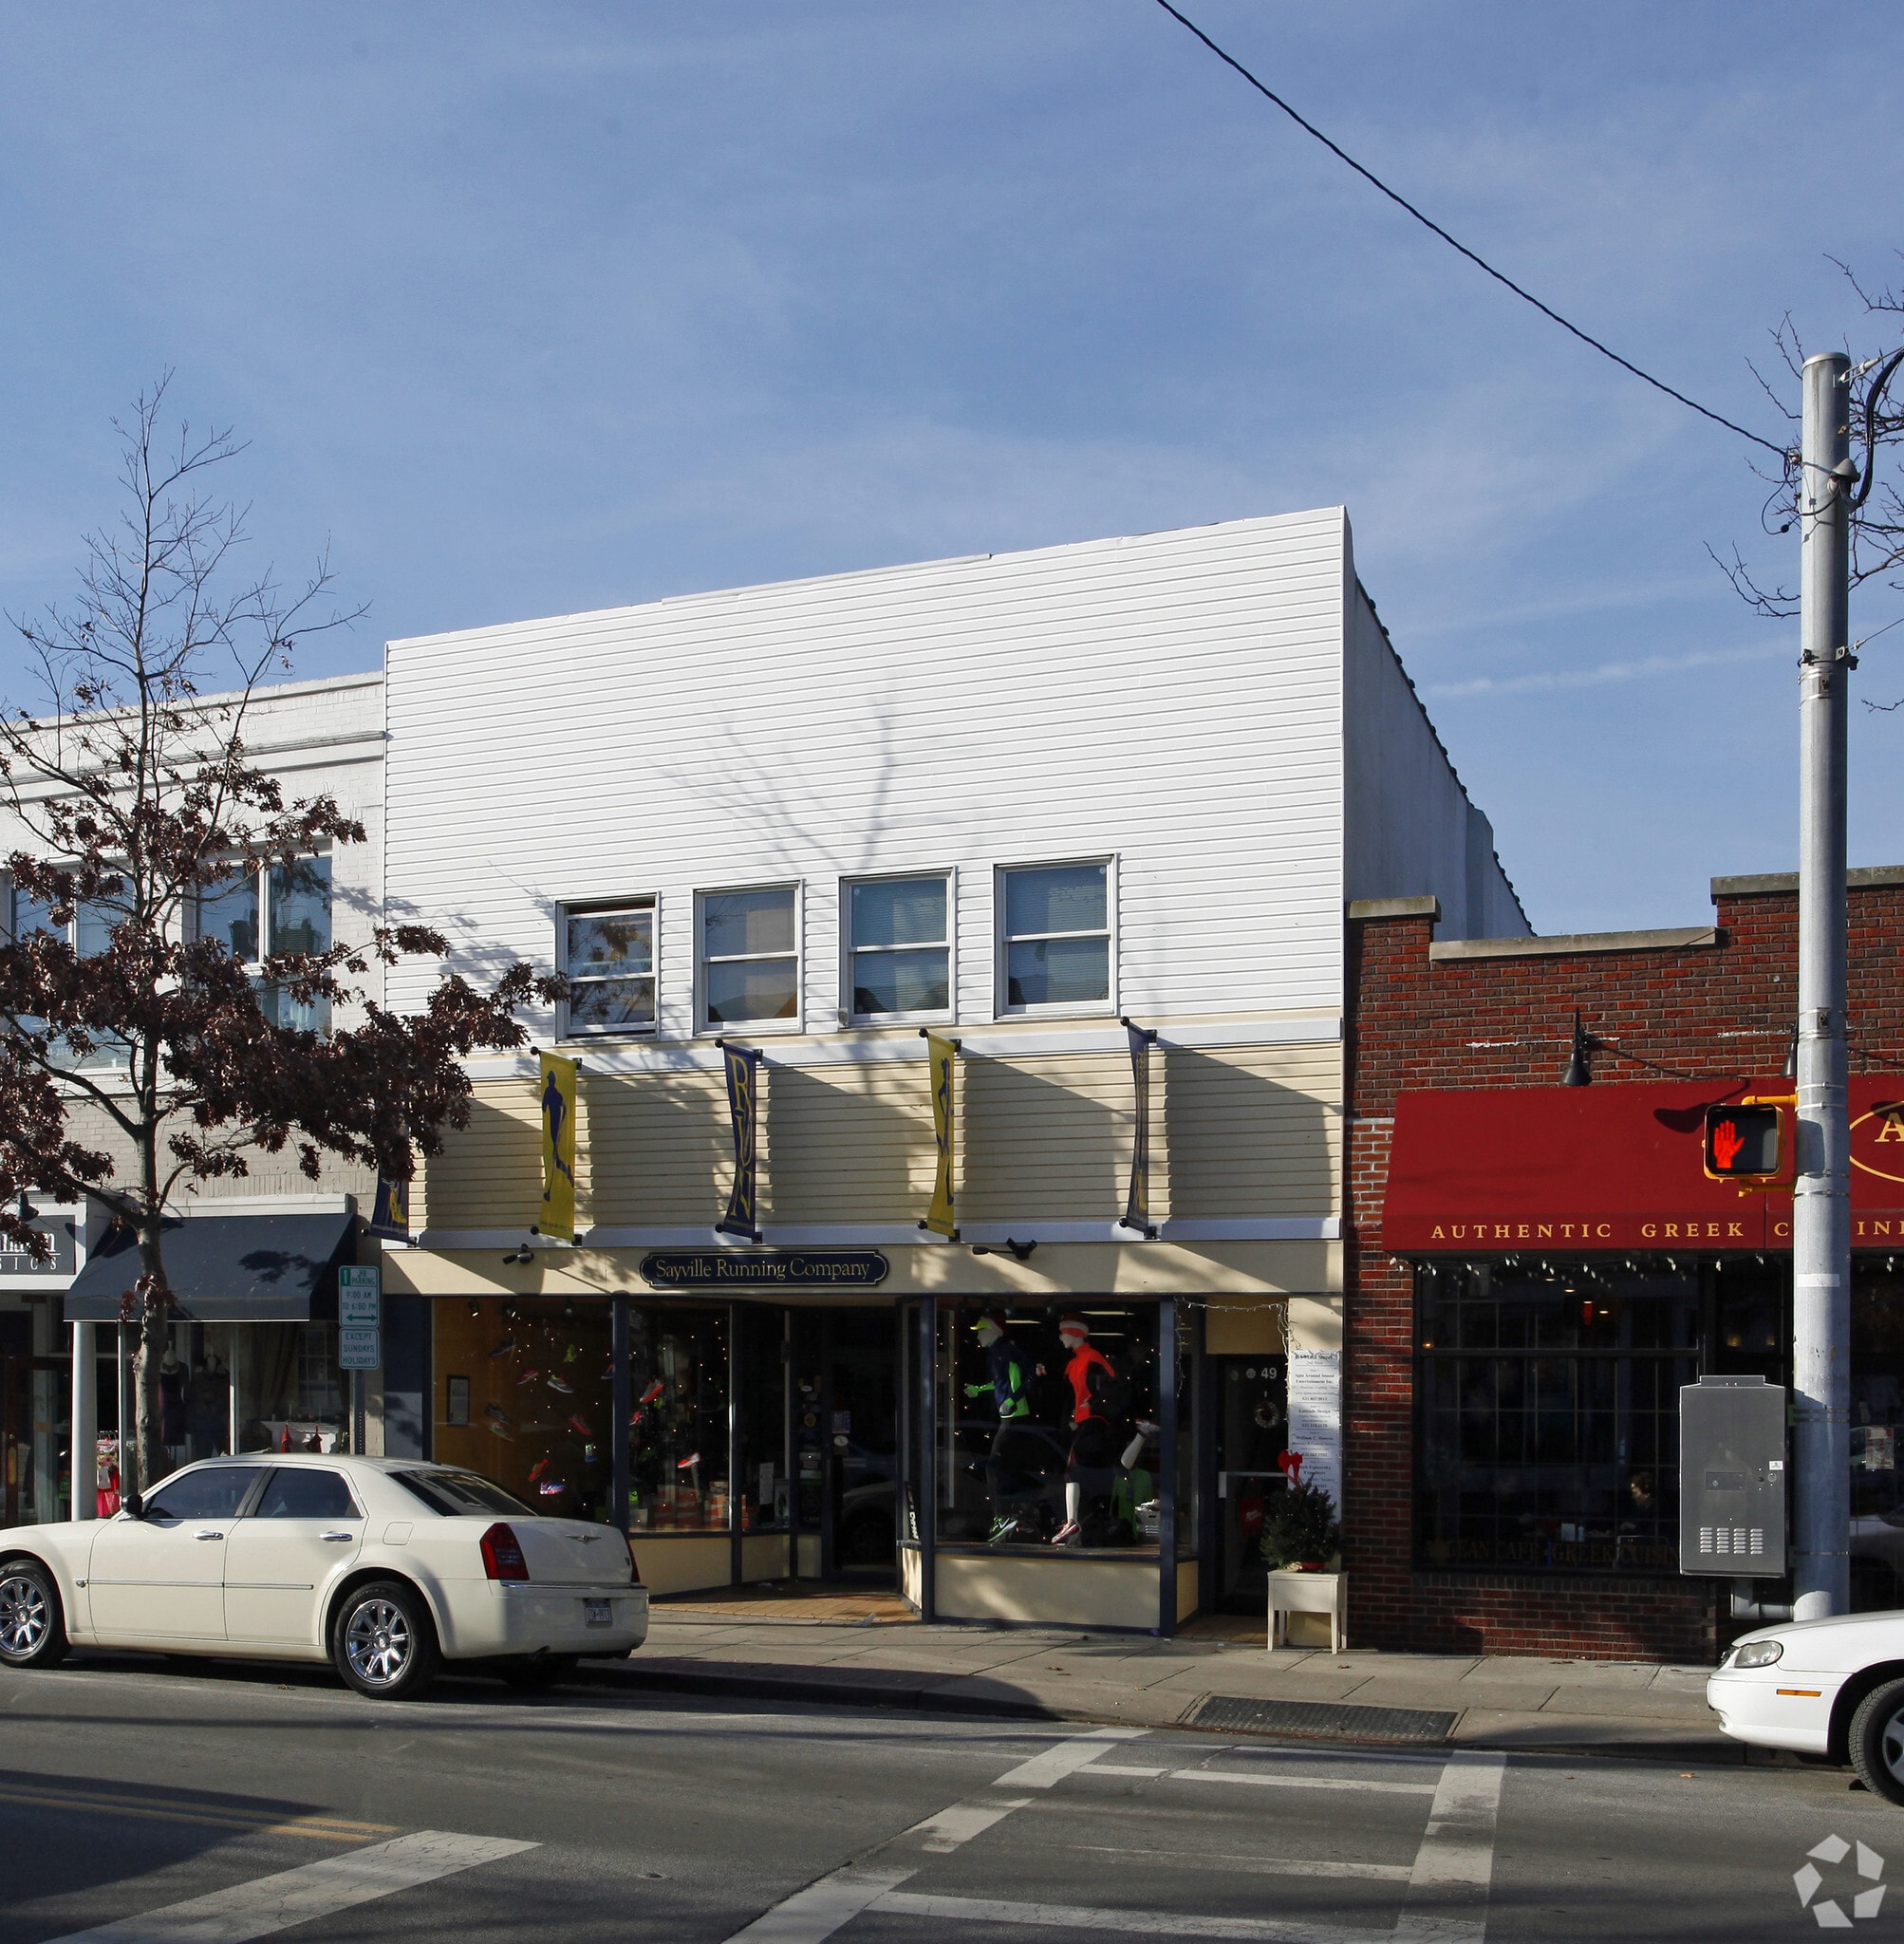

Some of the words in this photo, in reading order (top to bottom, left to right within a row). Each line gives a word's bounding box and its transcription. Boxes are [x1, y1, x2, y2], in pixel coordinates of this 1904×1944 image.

[1430, 1224, 1612, 1239] AUTHENTIC
[1641, 1223, 1745, 1238] GREEK
[656, 1259, 711, 1281] Sayville
[717, 1258, 787, 1280] Running
[790, 1258, 870, 1280] Company
[351, 1277, 375, 1285] PARKING
[345, 1291, 361, 1299] 9:00
[345, 1332, 372, 1340] EXCEPT
[344, 1344, 375, 1353] SUNDAYS
[1260, 1367, 1278, 1379] 49
[1619, 1542, 1680, 1565] CUISIN
